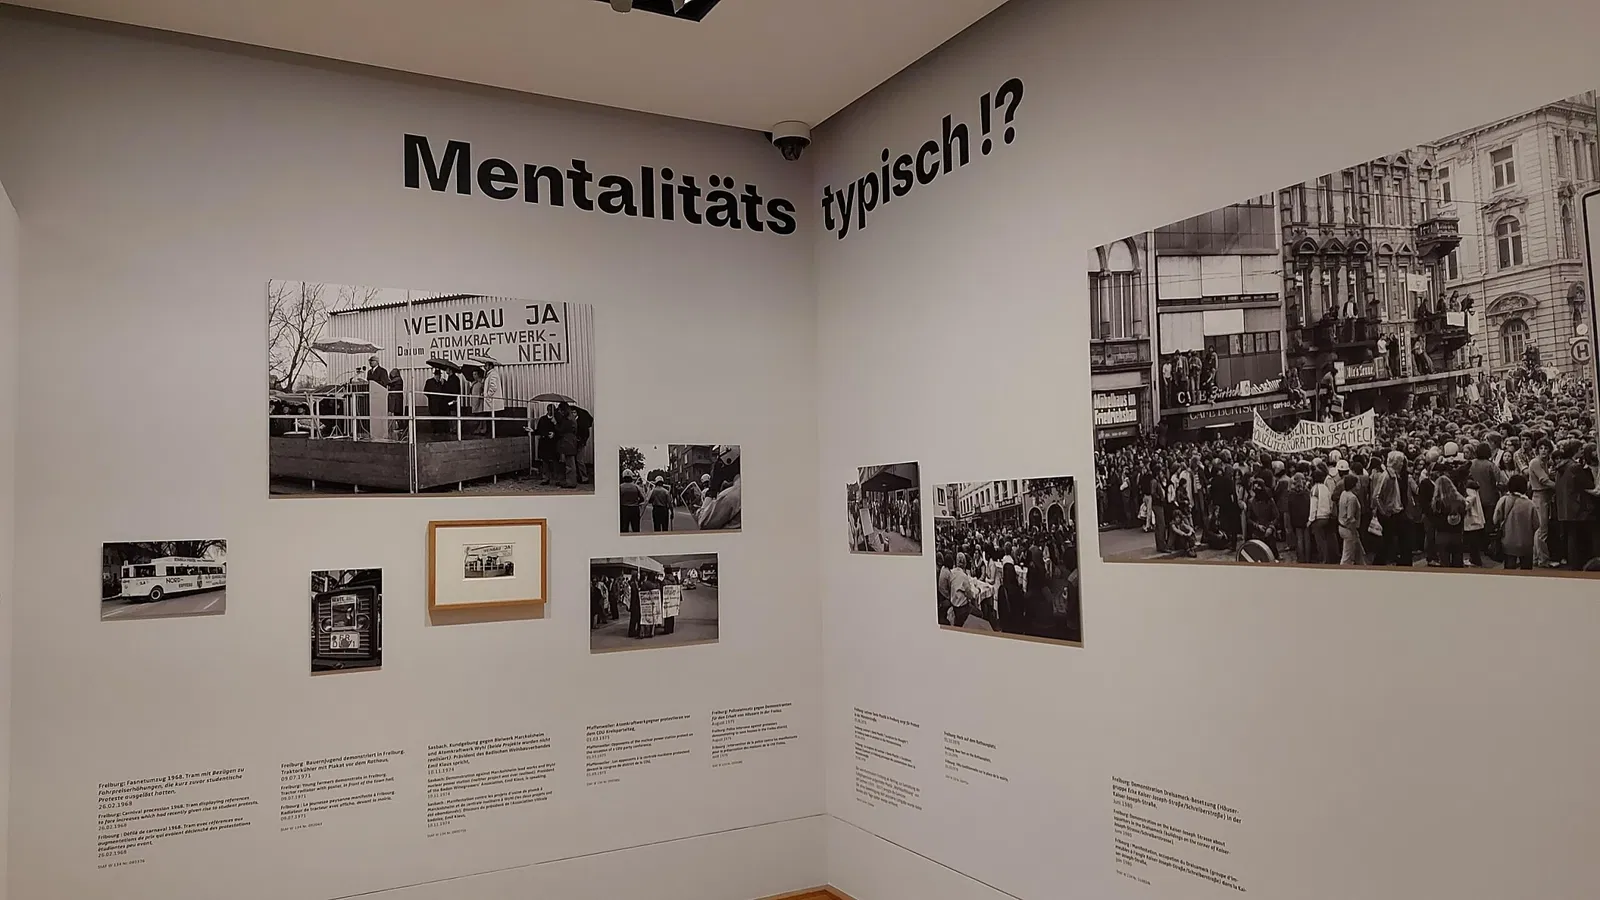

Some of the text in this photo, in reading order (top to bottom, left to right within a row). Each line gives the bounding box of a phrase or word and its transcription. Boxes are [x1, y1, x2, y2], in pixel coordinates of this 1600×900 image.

[404, 133, 796, 236] Mentalitäts
[404, 304, 560, 336] WEINBAU JA
[518, 342, 562, 362] NEIN
[1576, 344, 1589, 358] H
[126, 777, 166, 785] Fasnetumzug
[124, 791, 153, 799] ausgelöst
[98, 800, 132, 809] 26.02.1968
